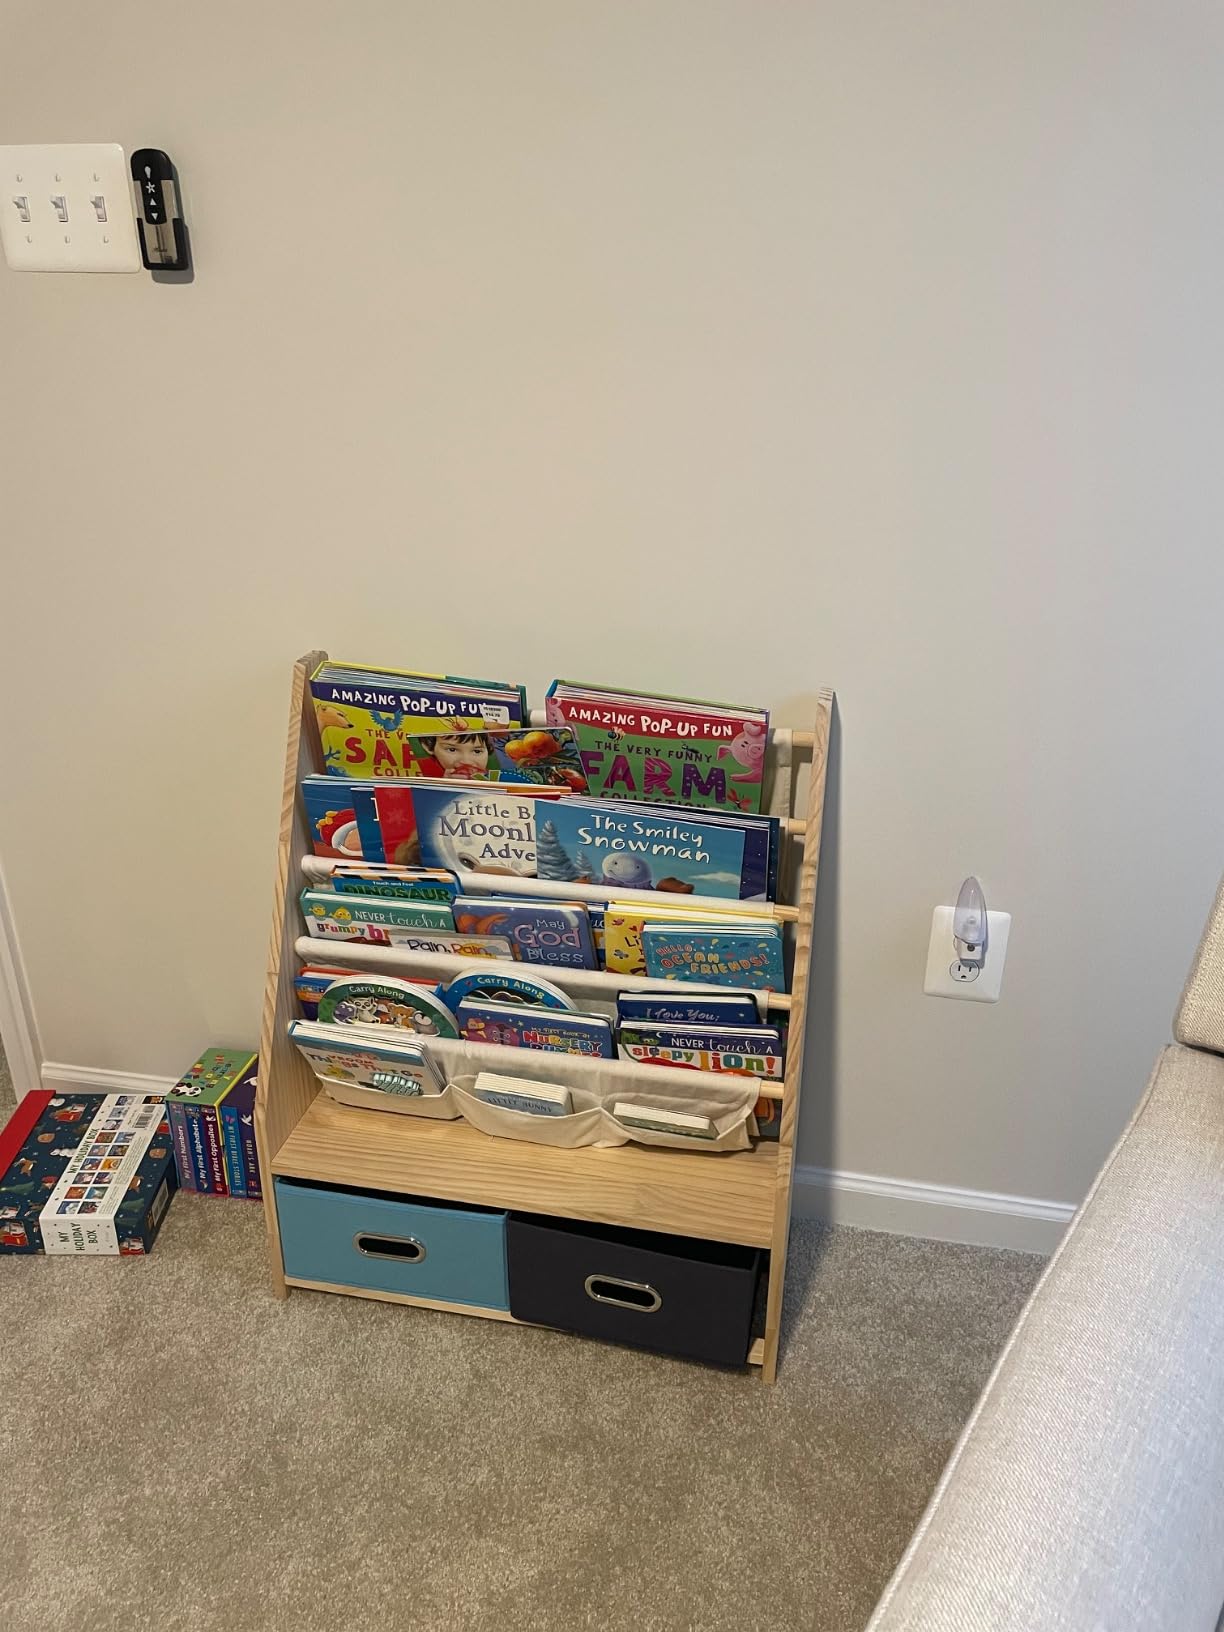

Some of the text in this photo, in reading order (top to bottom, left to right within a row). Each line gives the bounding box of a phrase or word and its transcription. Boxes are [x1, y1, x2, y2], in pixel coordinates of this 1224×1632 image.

[331, 688, 396, 706] AMAZING
[400, 695, 456, 715] POP-UP
[568, 707, 733, 737] AMAZING POP-UP FUN
[365, 728, 390, 739] THE
[595, 740, 713, 763] THE VERY FUNNY
[579, 750, 726, 804] FARM
[453, 800, 510, 819] Little
[437, 815, 535, 843] Moonl
[591, 814, 703, 848] The Smiley
[479, 842, 536, 862] Adve
[577, 827, 711, 865] Snowman
[343, 883, 451, 901] DINOSAUR
[354, 910, 385, 922] NEVER
[386, 911, 438, 928] touch
[535, 919, 566, 932] May
[316, 923, 365, 936] grumpy
[514, 924, 582, 949] God
[526, 946, 584, 963] Bless
[661, 951, 720, 969] OCEAN
[348, 985, 405, 1000] Carry Along
[477, 977, 545, 1000] Carry Along
[671, 1037, 704, 1049] NEVER
[708, 1038, 762, 1055] touch
[632, 1046, 776, 1076] sleepy lion!
[66, 1164, 80, 1174] MY
[73, 1140, 93, 1163] HOLIDAY
[57, 1231, 70, 1243] MY
[70, 1222, 86, 1251] HOLIDAY
[86, 1230, 99, 1244] BOX
